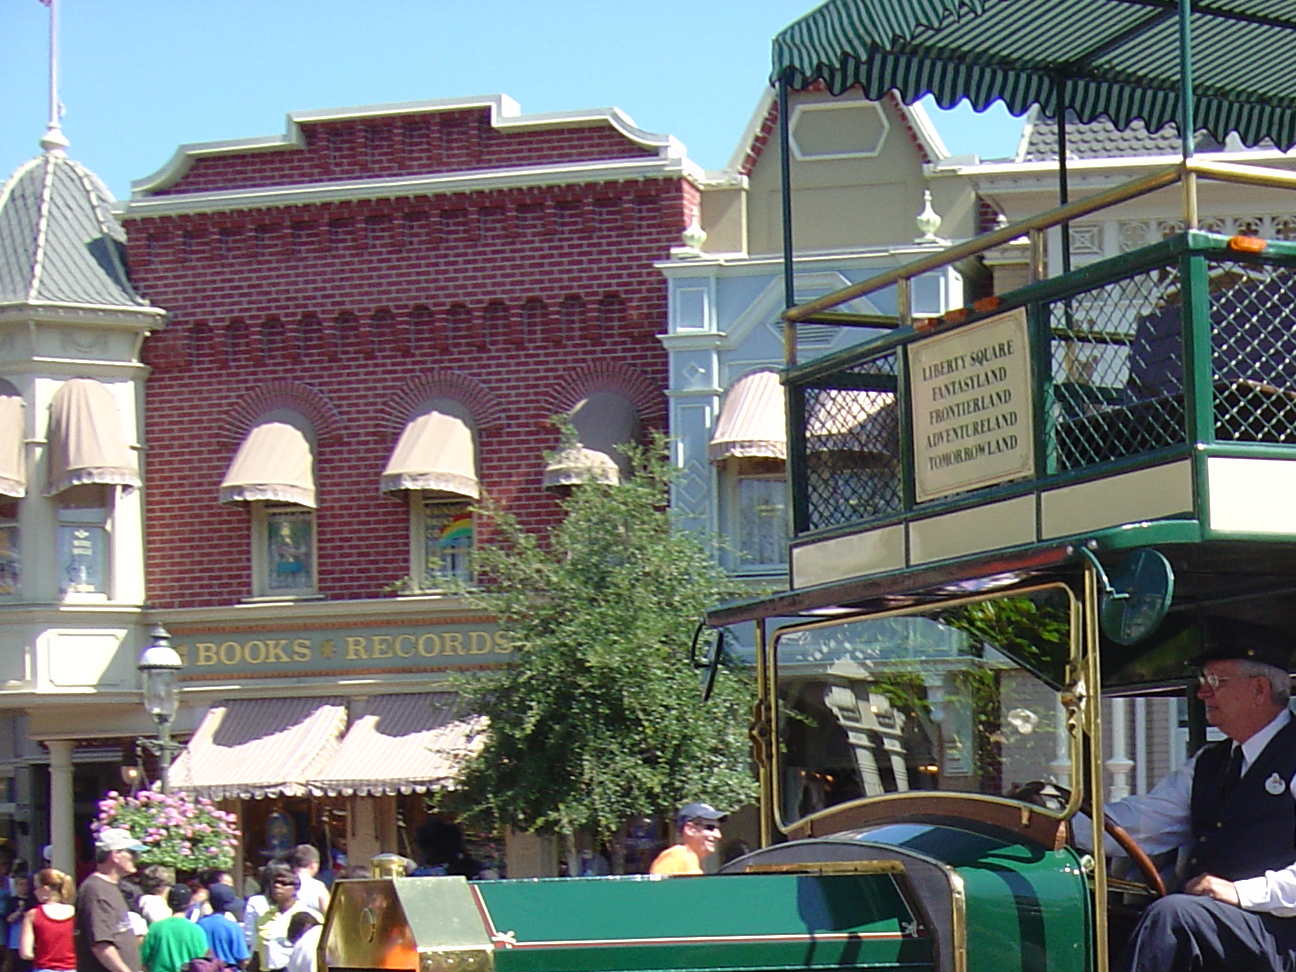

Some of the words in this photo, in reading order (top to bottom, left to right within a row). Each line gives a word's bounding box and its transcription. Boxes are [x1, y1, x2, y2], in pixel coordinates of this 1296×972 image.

[922, 354, 967, 381] LIBERTY
[969, 340, 1014, 366] SQUARE
[932, 366, 1007, 401] FANTASYLAND
[929, 389, 1012, 425] FRONTIERLAND
[925, 411, 1018, 450] ADVENTURELAND
[928, 434, 1018, 471] TOMORROWLAND
[195, 638, 312, 666] BOOKS
[344, 630, 514, 660] RECORDS
